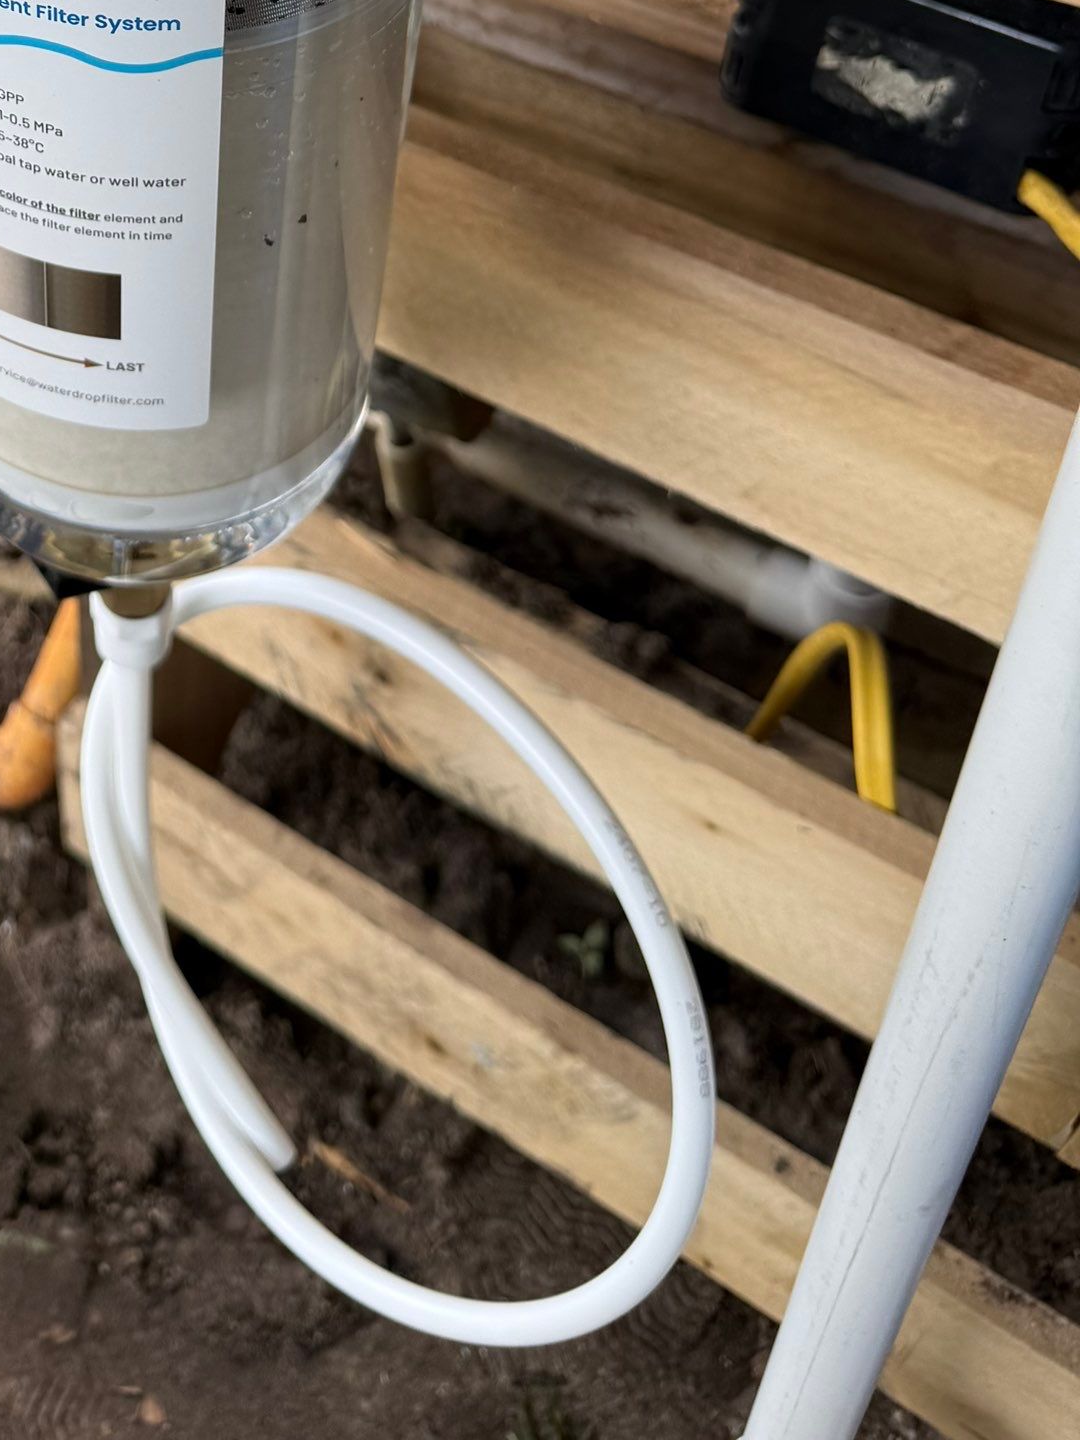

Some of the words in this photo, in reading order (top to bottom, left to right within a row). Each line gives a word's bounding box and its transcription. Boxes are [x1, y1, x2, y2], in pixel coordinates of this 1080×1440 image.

[36, 3, 89, 28] Filter
[95, 12, 181, 34] System
[34, 120, 64, 137] MPa
[19, 159, 41, 174] tap
[44, 166, 86, 183] water
[90, 174, 105, 184] or
[109, 177, 138, 188] well
[142, 177, 186, 188] water
[0, 188, 28, 204] color
[30, 200, 43, 210] of
[46, 202, 66, 215] the
[70, 207, 101, 222] filter
[104, 213, 156, 224] element
[159, 213, 183, 224] and
[20, 212, 39, 224] the
[42, 217, 71, 232] filter
[74, 226, 126, 240] element
[129, 230, 141, 241] in
[143, 231, 173, 241] time
[106, 361, 145, 372] LAST
